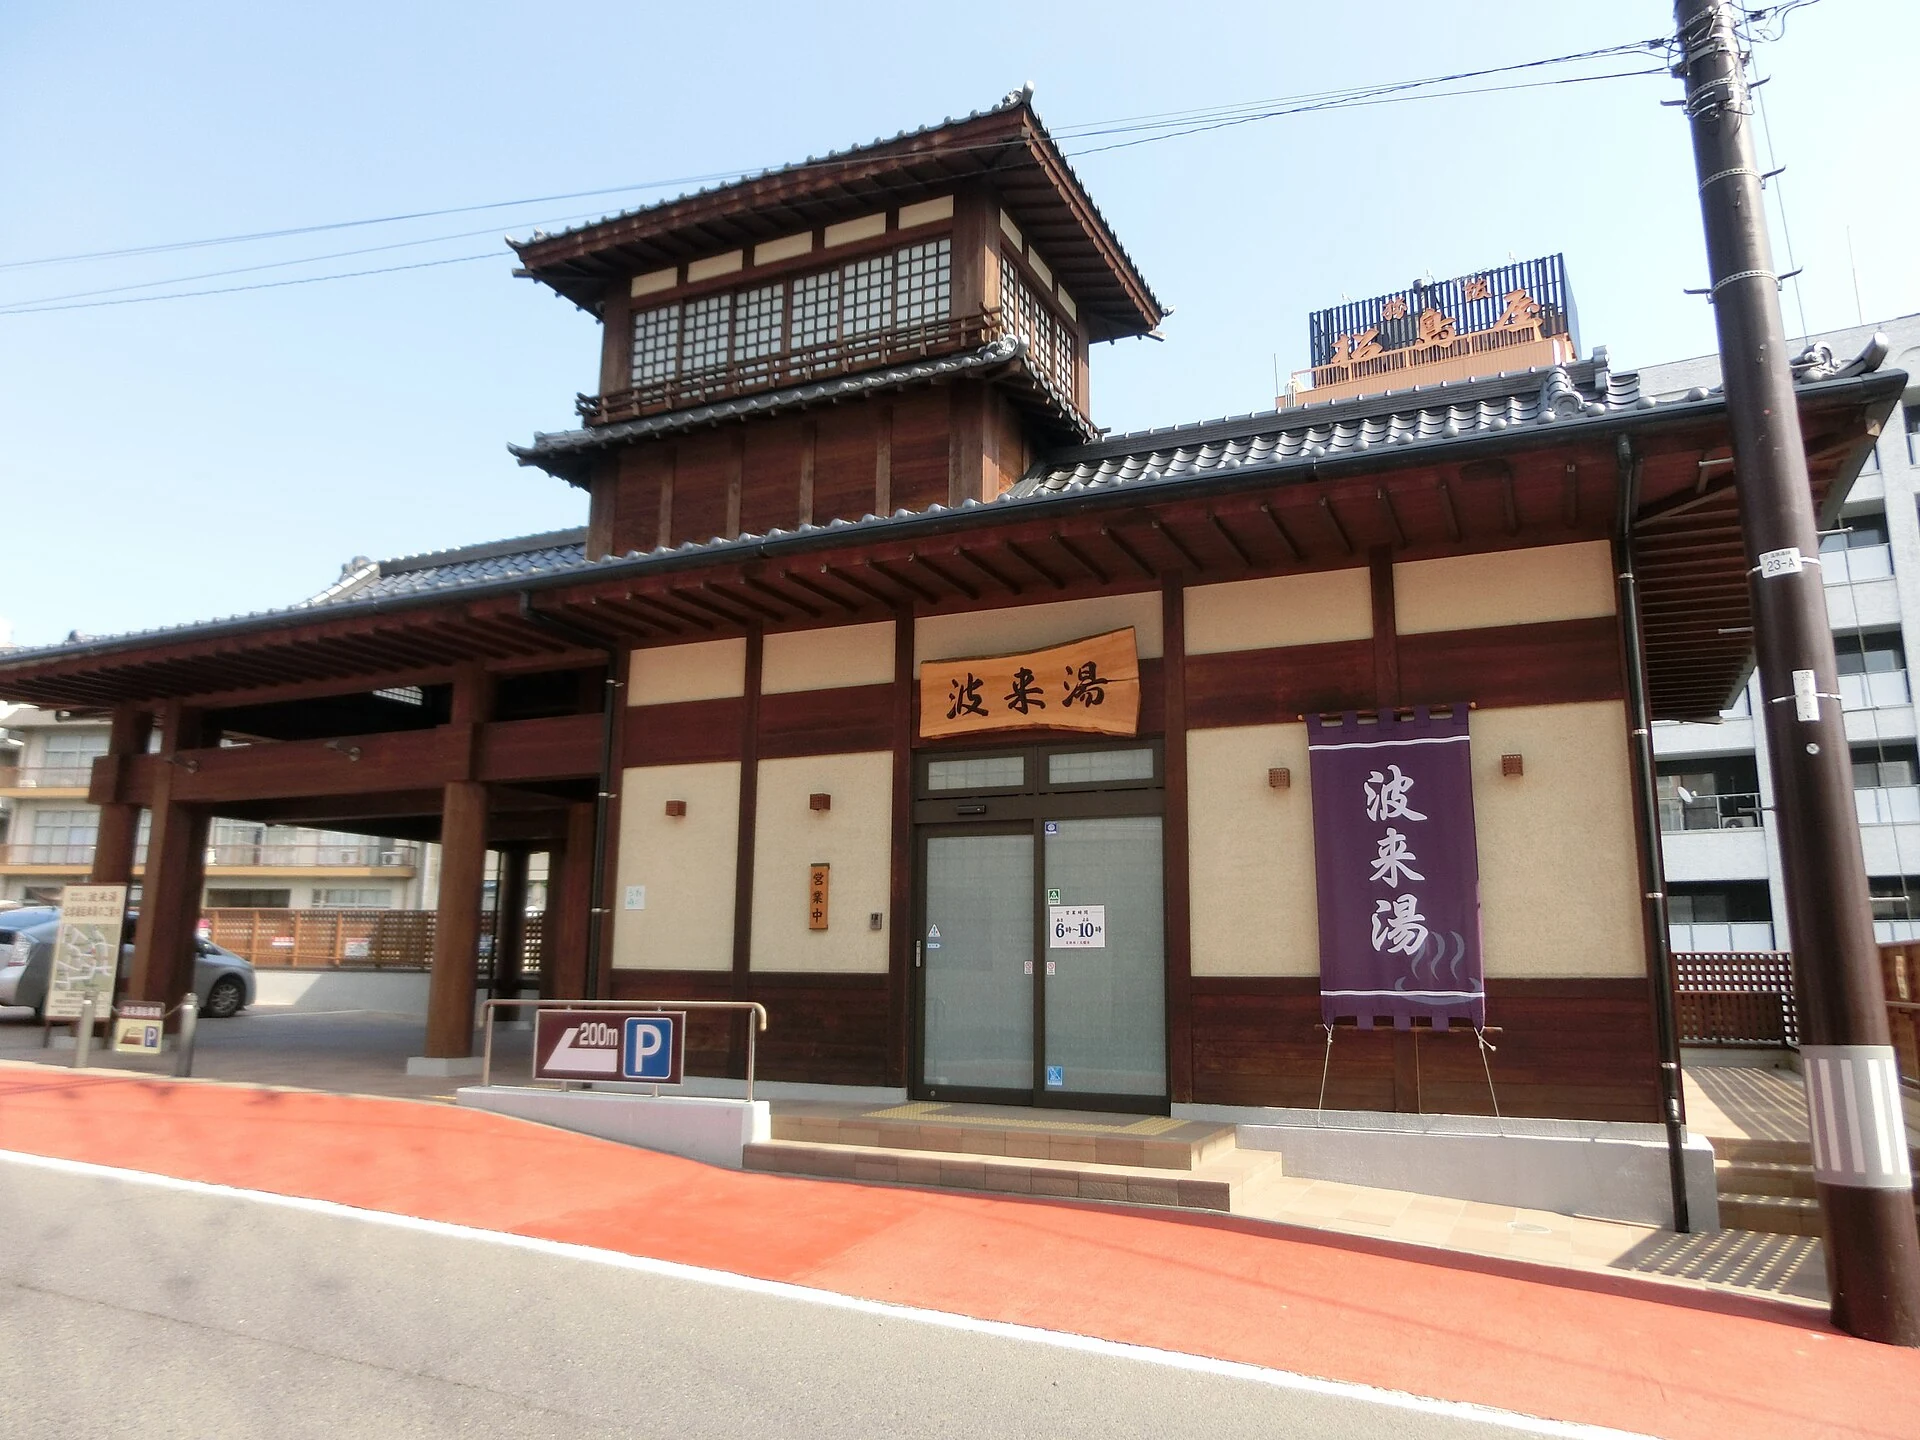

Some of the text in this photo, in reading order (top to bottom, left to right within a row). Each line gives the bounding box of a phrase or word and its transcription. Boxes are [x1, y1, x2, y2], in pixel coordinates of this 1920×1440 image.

[1767, 557, 1795, 572] 23-A
[947, 660, 1108, 719] 波来湯
[1363, 763, 1429, 956] 波来湯
[812, 871, 824, 923] 営業中
[579, 1022, 662, 1073] 200m P
